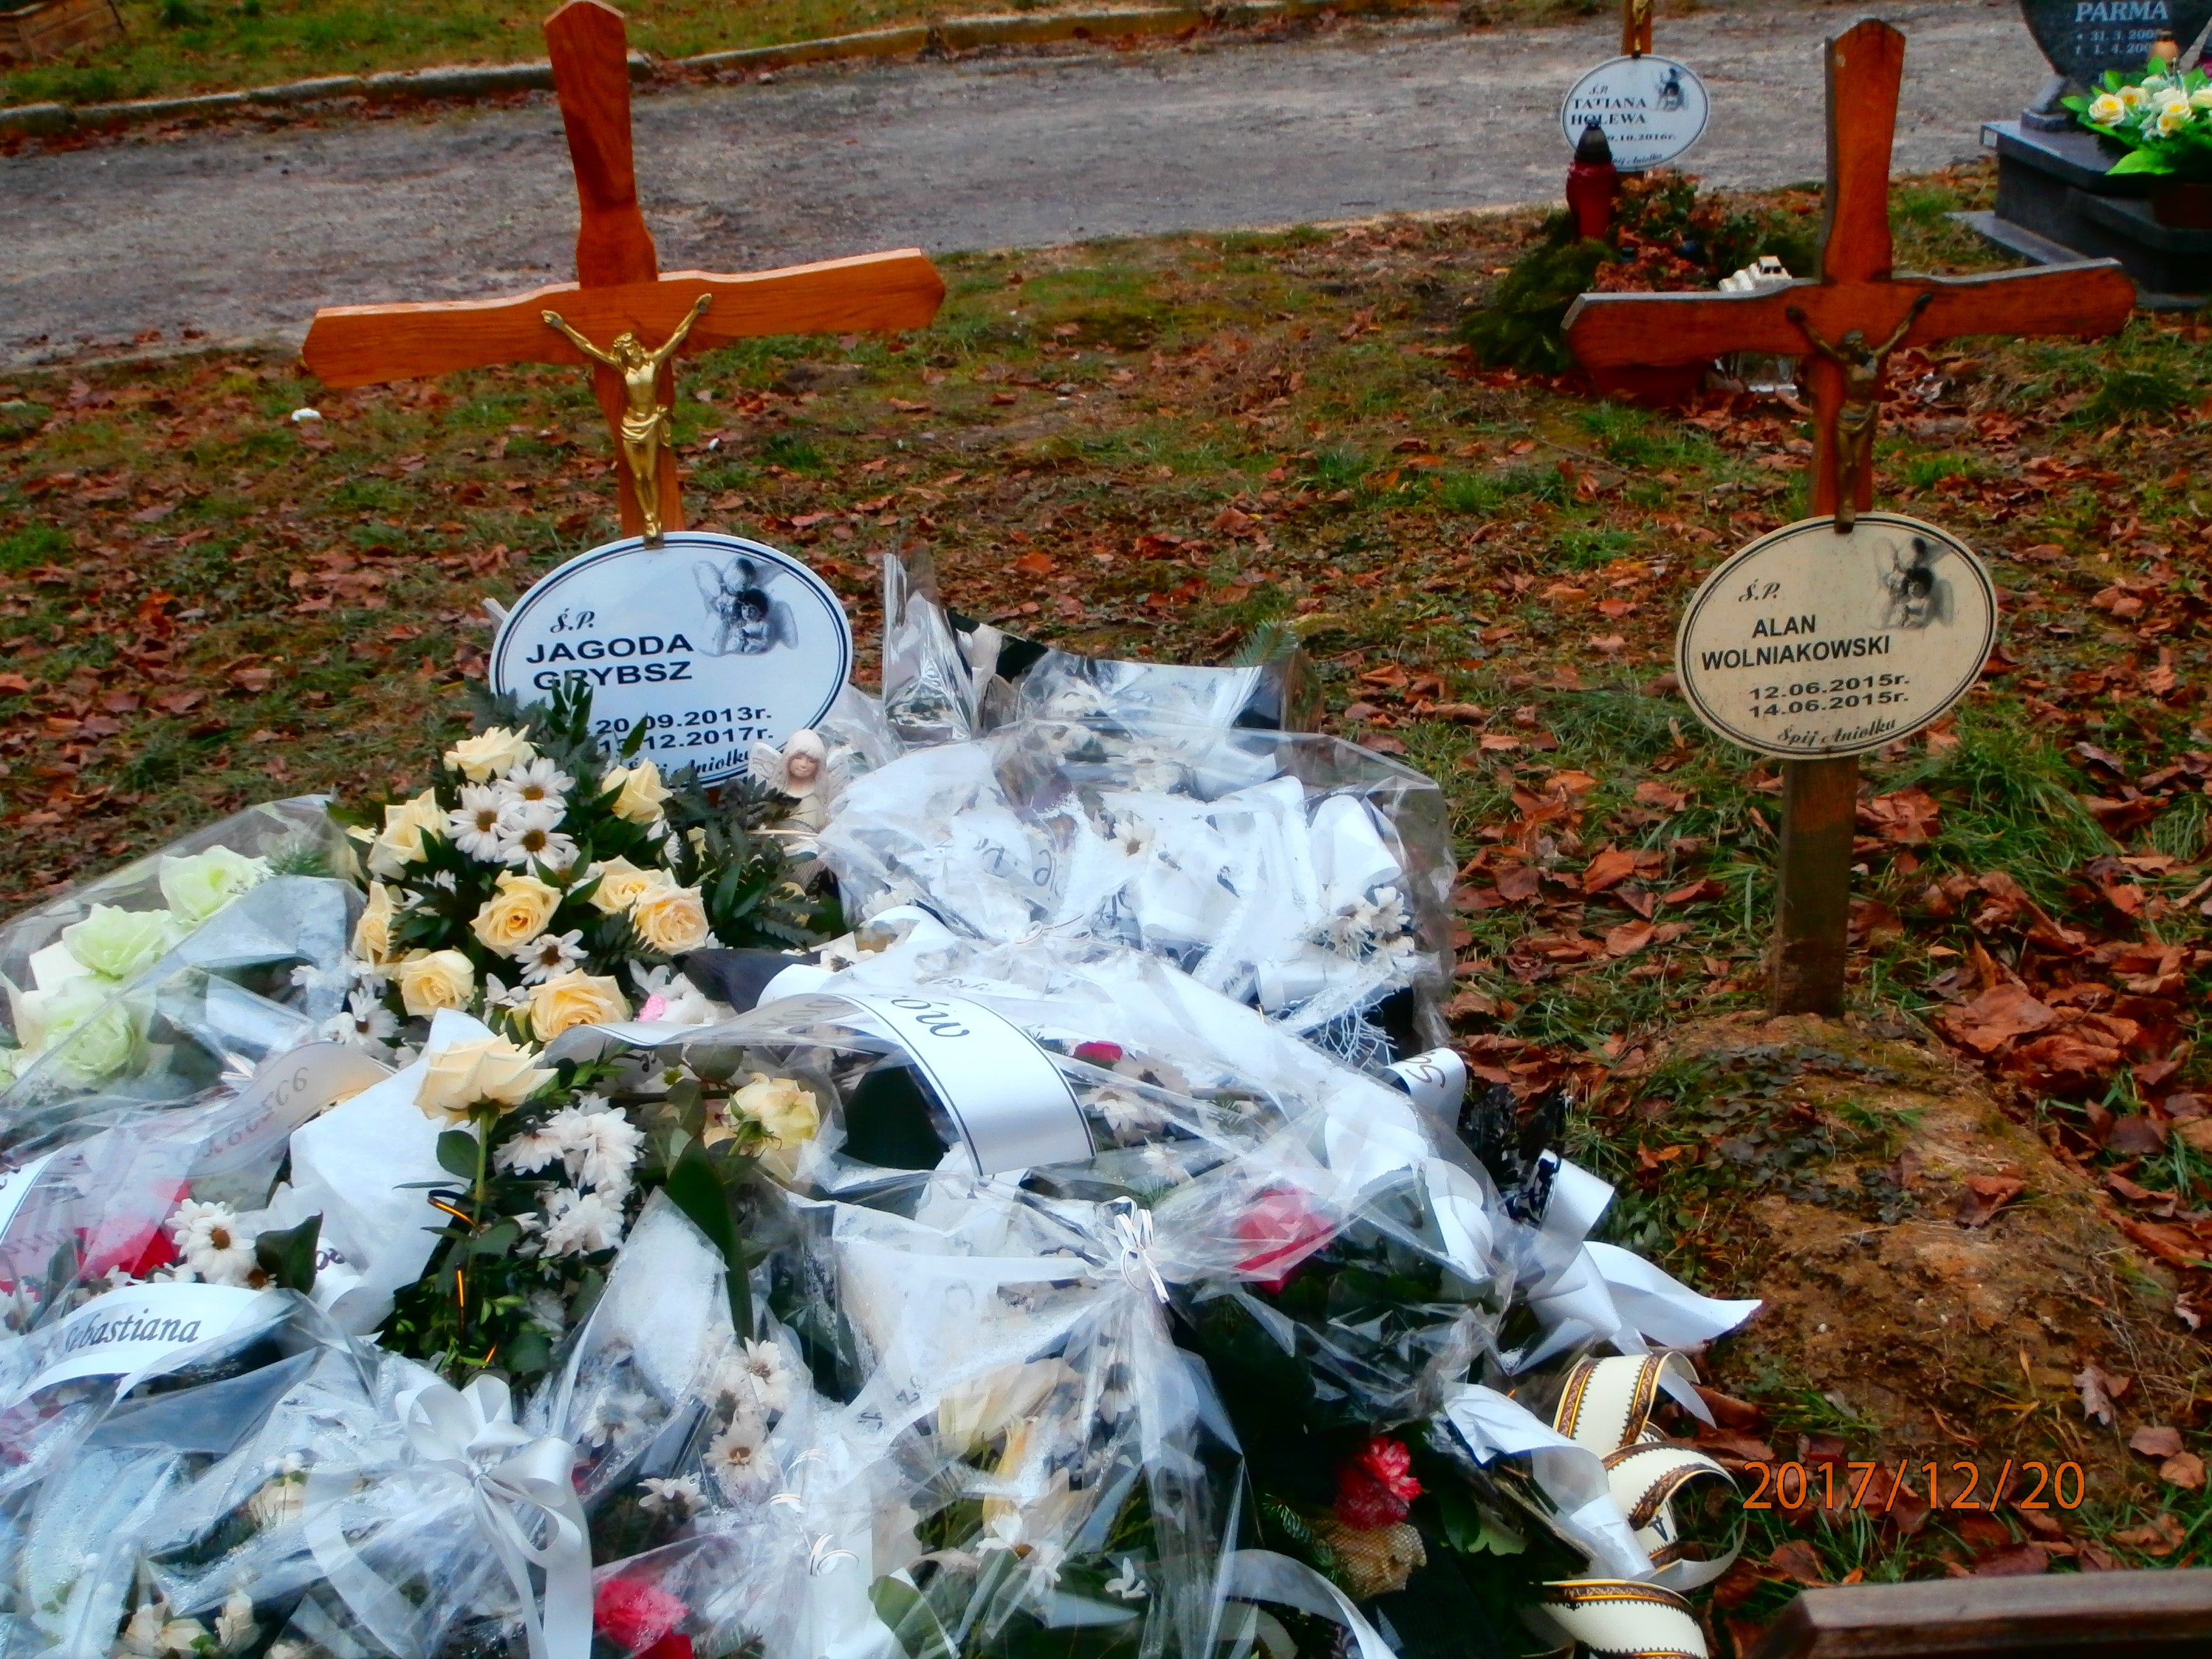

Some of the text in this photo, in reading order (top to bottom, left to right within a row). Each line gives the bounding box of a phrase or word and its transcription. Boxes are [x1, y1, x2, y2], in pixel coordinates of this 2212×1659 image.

[2075, 1, 2168, 22] PARMA
[1572, 97, 1647, 109] TATIANA
[1738, 578, 1781, 603] Ś.P.
[550, 607, 595, 633] Ś.P.
[1751, 615, 1816, 639] ALAN
[526, 634, 694, 664] JAGODA
[1702, 635, 1891, 671] WOLNIAKOWSKI
[533, 661, 693, 691] GRYBSZ
[1749, 673, 1911, 700] 12.06.2015r.
[1749, 691, 1909, 718] 14.06.2015r.
[595, 706, 773, 735] 2009.2013r.
[599, 726, 774, 752] 112.2017r.
